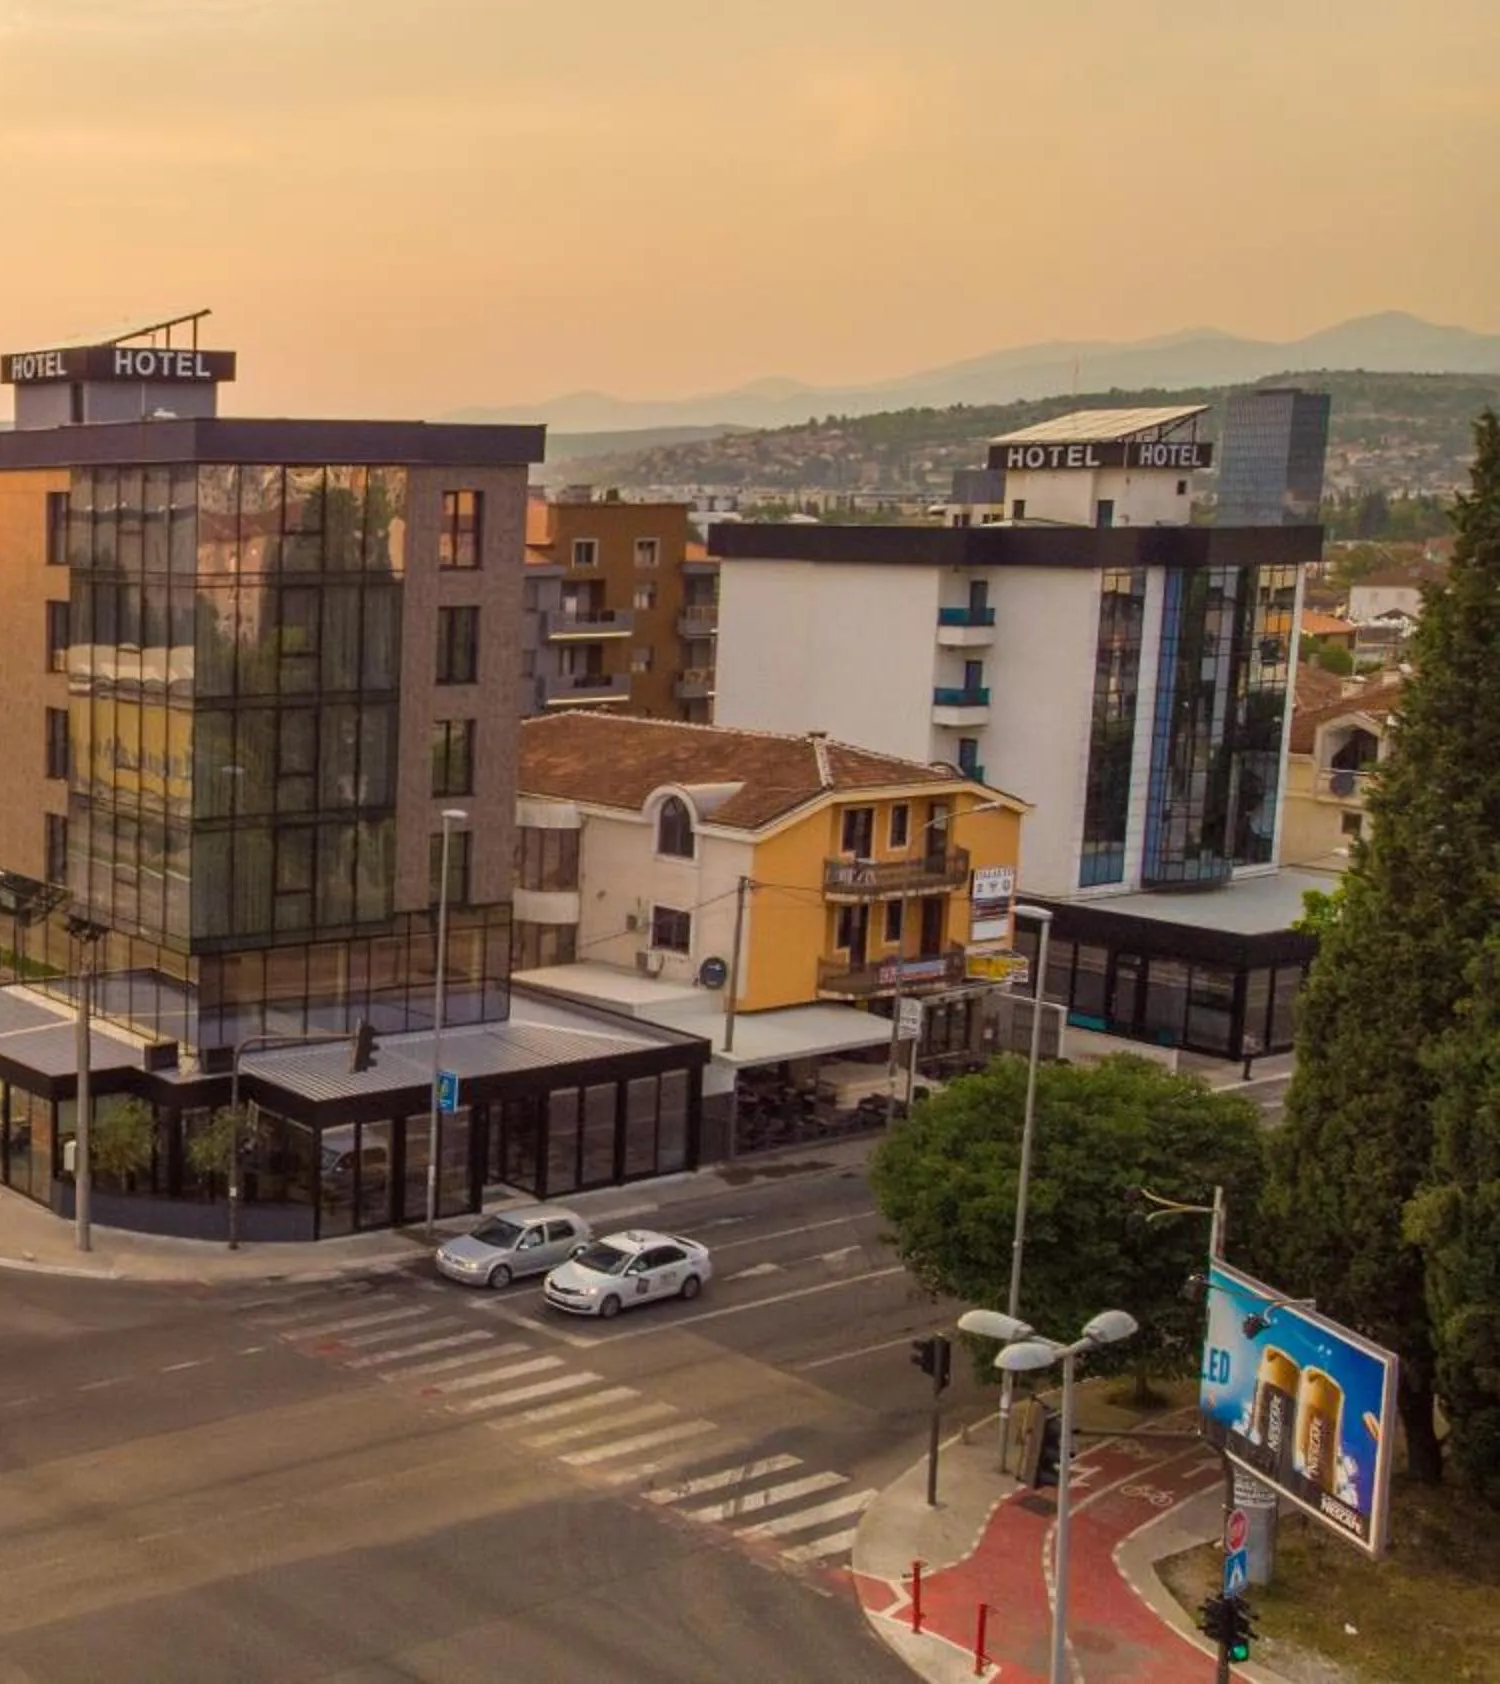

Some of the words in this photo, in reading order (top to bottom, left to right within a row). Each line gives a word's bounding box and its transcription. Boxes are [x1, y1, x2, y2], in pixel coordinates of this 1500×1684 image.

[11, 351, 68, 380] HOTEL
[114, 349, 211, 378] HOTEL
[1007, 445, 1102, 469] HOTEL
[1139, 443, 1202, 467] HOTEL
[1201, 1347, 1231, 1386] ED
